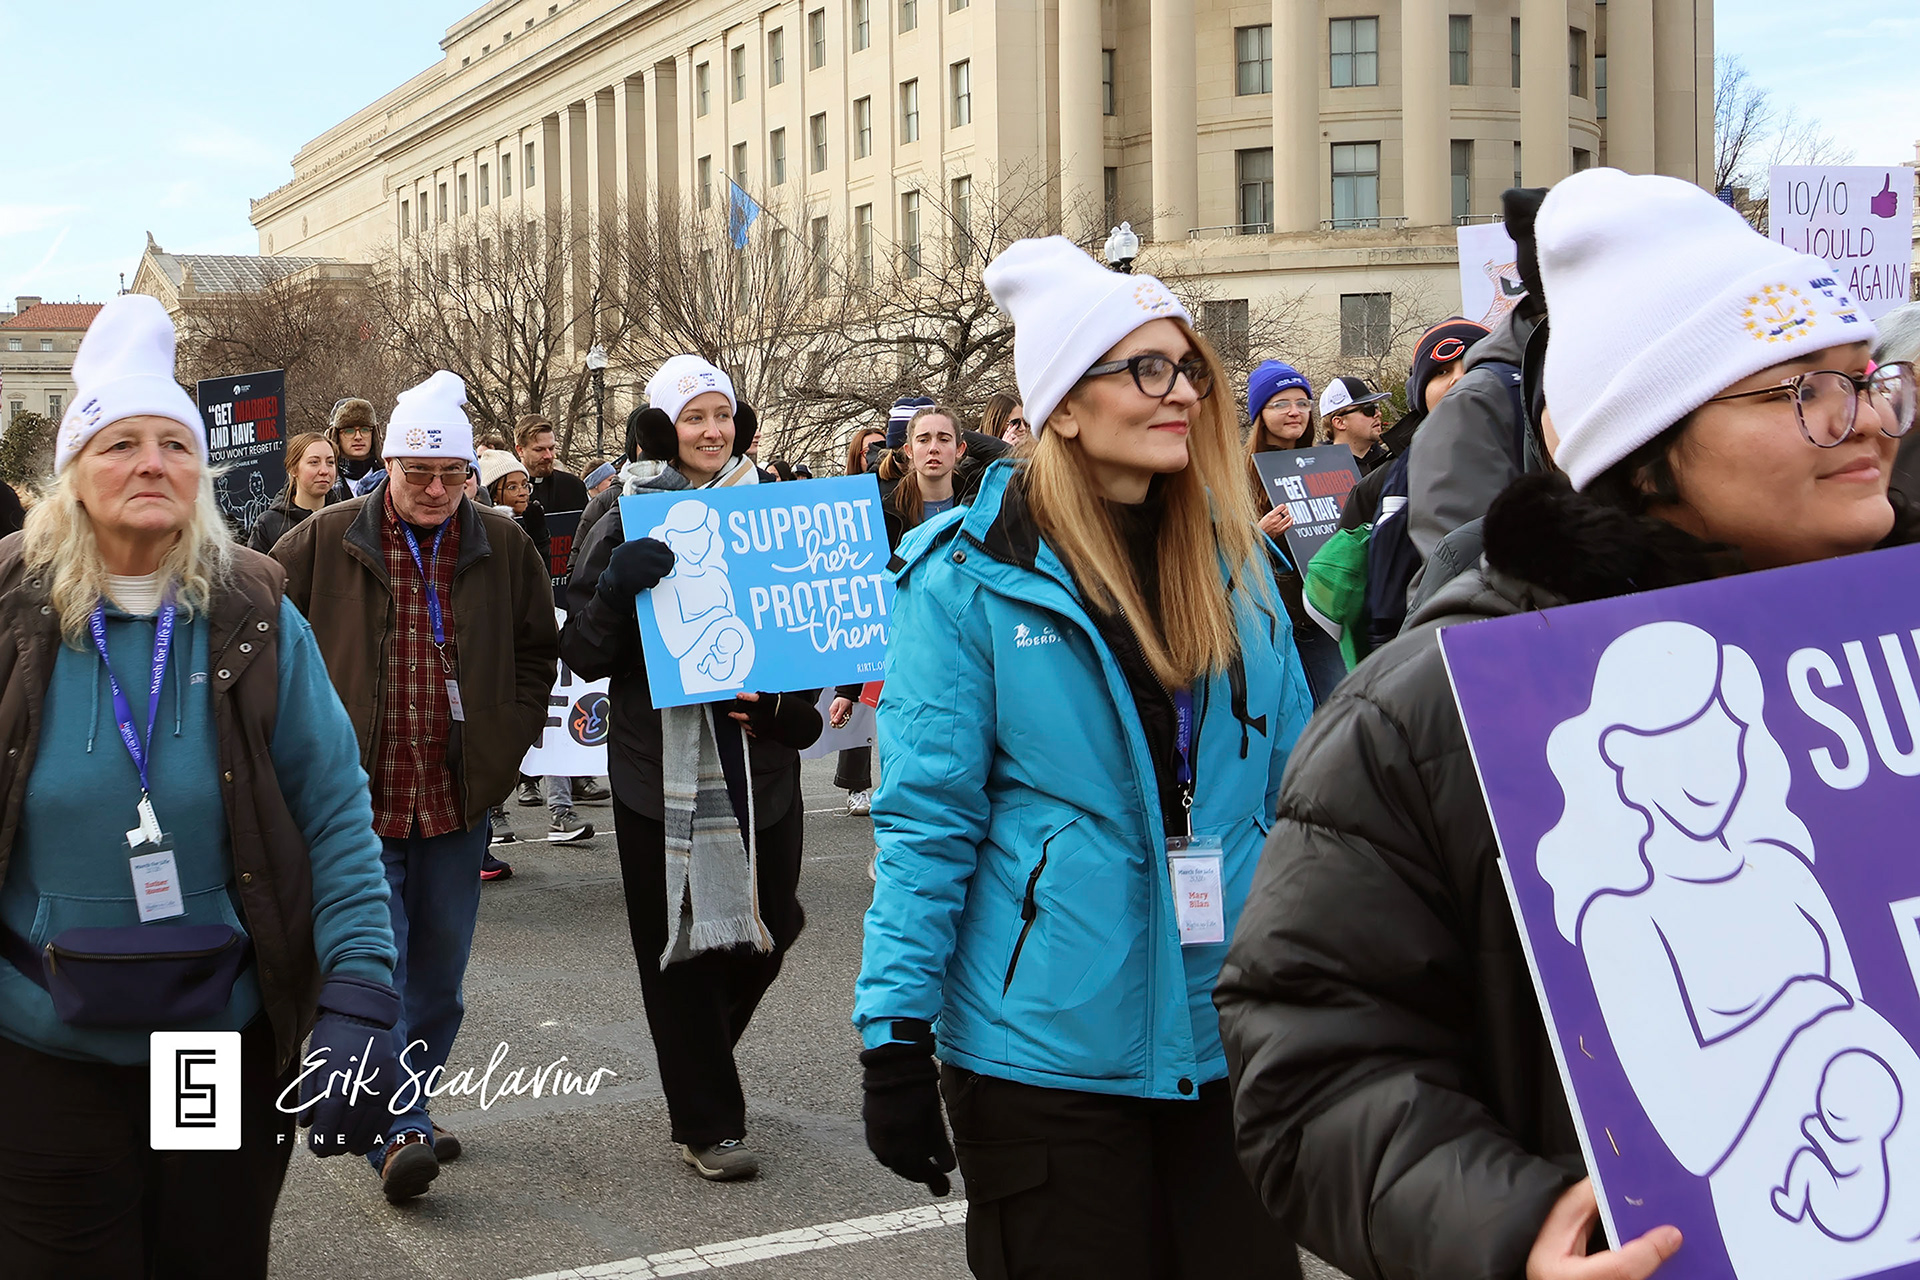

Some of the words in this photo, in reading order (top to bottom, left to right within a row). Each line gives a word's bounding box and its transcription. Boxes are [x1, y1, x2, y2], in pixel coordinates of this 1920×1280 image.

[1787, 174, 1848, 222] 10/10
[1848, 262, 1906, 302] AGAIN
[234, 395, 279, 423] MARRIED
[210, 426, 230, 450] AND
[231, 421, 255, 446] HAVE
[1308, 496, 1342, 522] HAVE
[728, 499, 873, 555] SUPPORT
[1295, 525, 1313, 538] YOU
[771, 530, 875, 575] her
[162, 606, 174, 628] 2026
[749, 574, 888, 631] PROTECT
[157, 628, 171, 646] Life
[153, 649, 167, 662] for
[150, 664, 165, 695] March
[1786, 629, 1920, 791] SU
[1188, 892, 1209, 900] Mary
